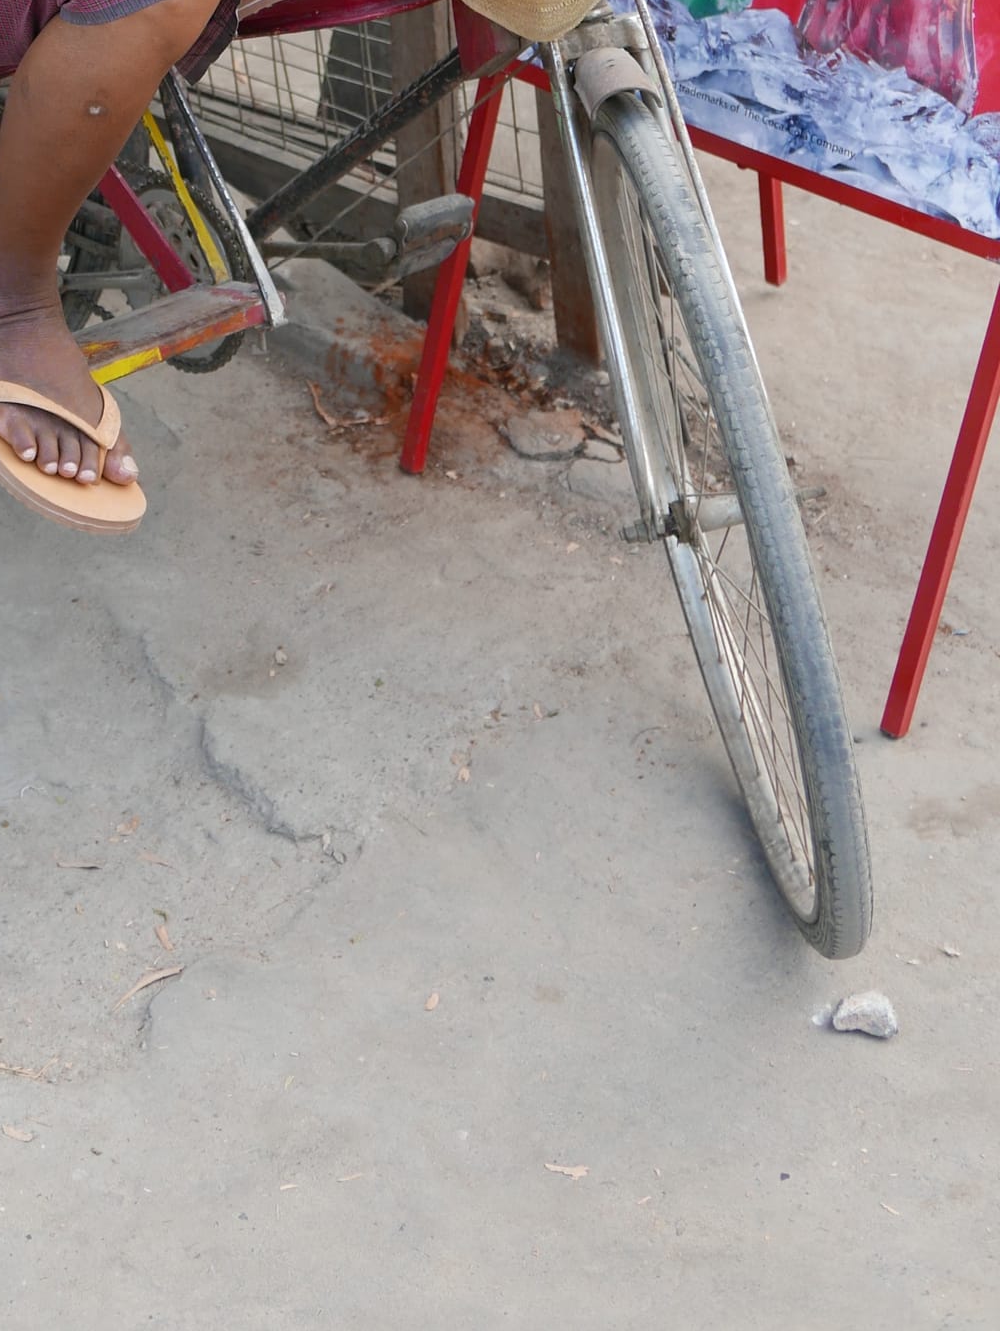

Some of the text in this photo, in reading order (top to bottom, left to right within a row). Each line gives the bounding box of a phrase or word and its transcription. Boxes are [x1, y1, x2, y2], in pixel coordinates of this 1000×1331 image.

[678, 83, 729, 110] trademarks
[730, 104, 740, 114] of
[743, 108, 760, 122] The
